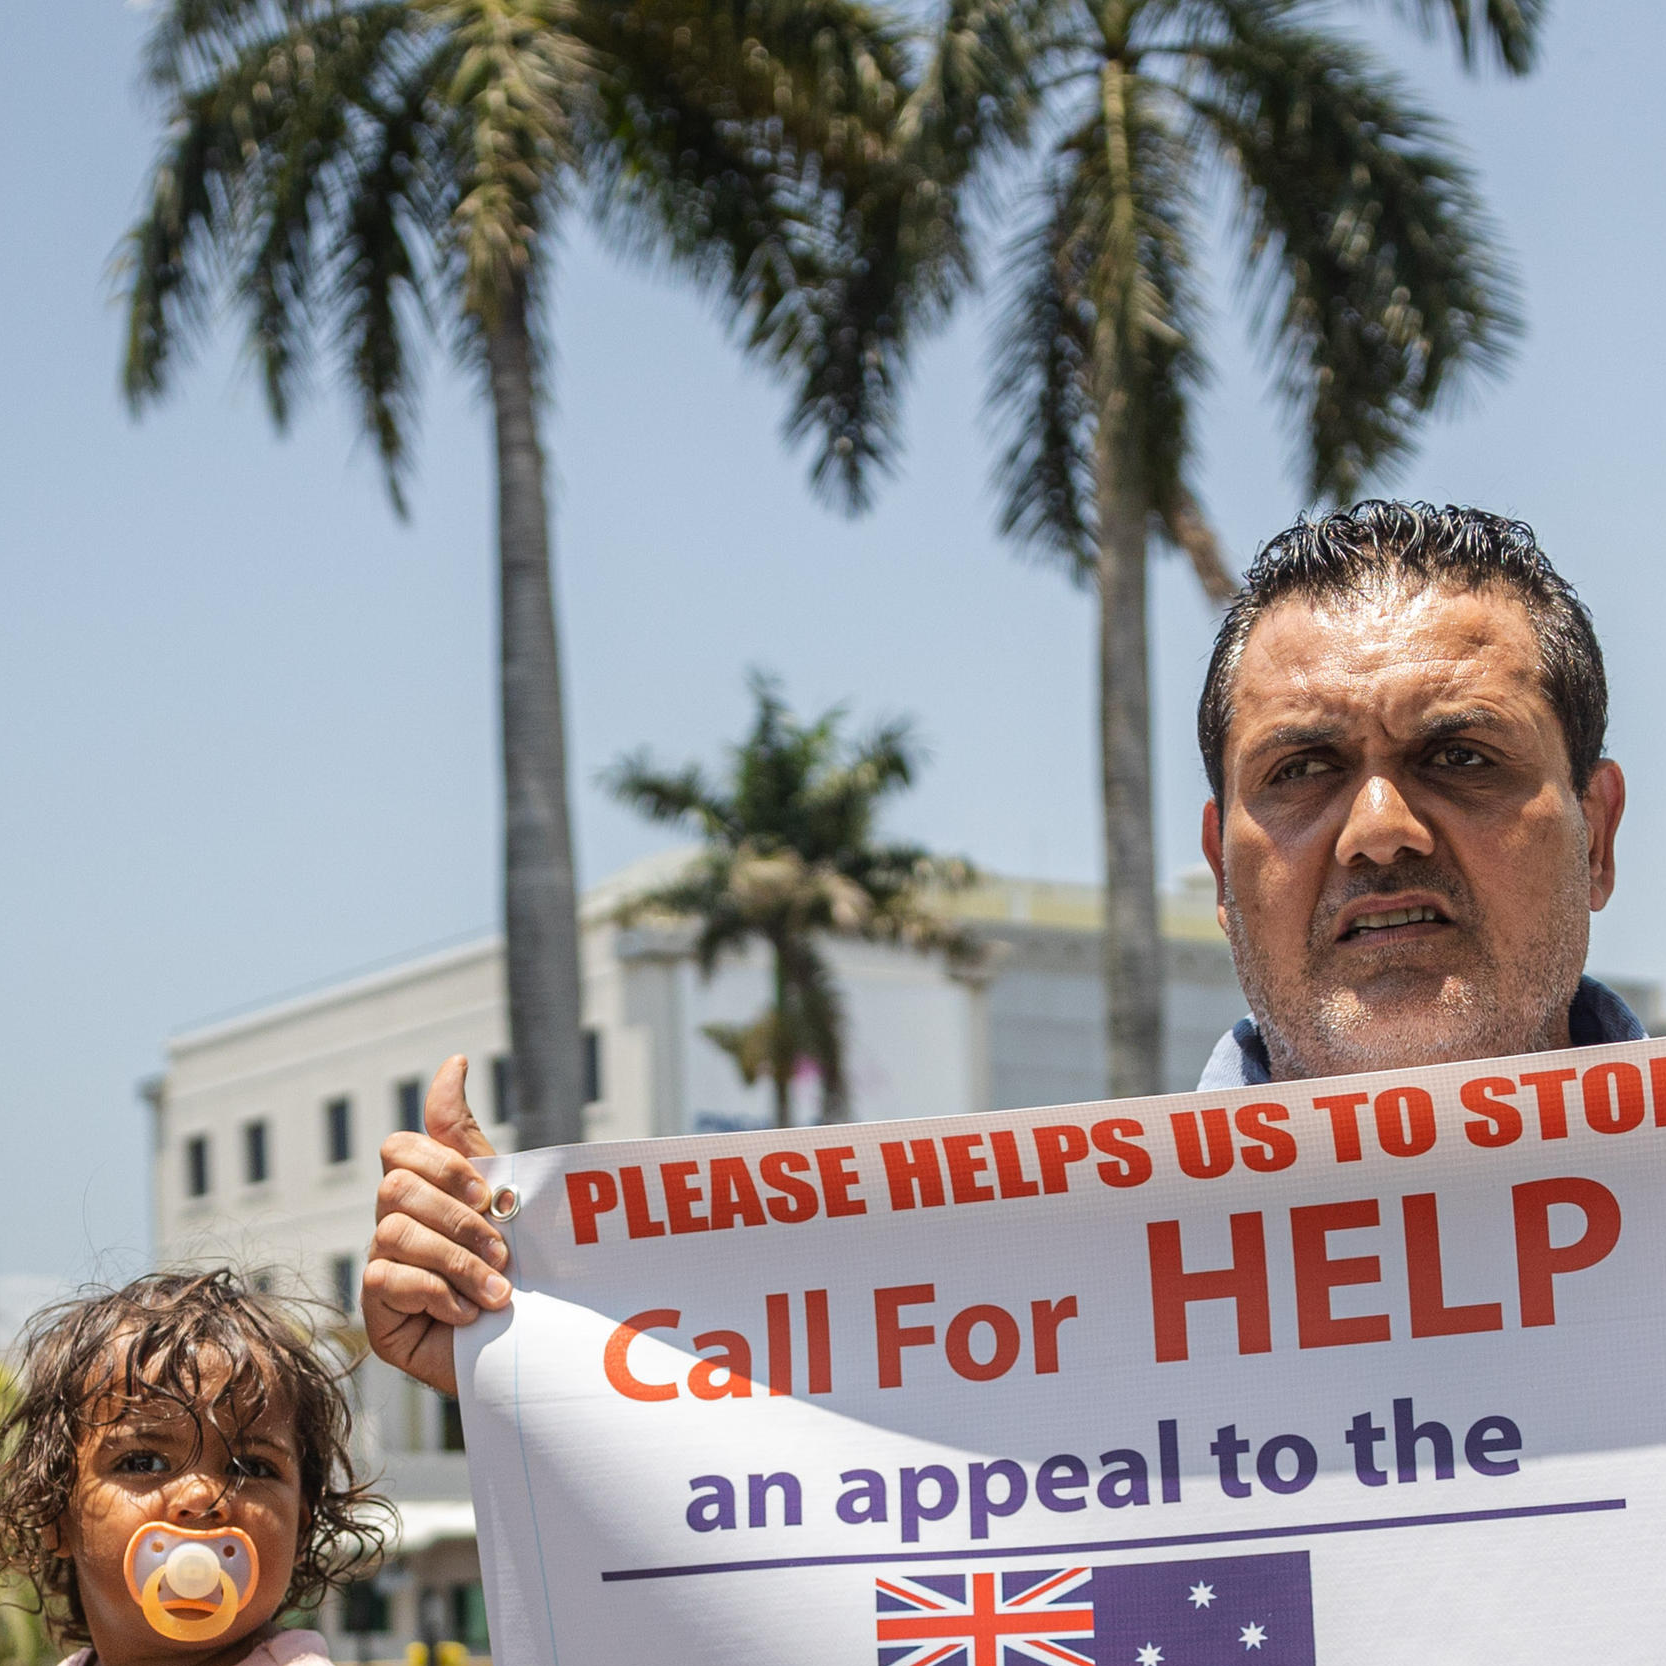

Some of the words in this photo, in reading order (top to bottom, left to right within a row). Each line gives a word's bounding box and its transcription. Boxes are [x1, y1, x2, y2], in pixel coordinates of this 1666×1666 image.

[565, 1145, 867, 1245] PLEASE
[878, 1117, 1153, 1211] HELPS
[1168, 1101, 1299, 1180] US
[1311, 1085, 1453, 1164] TO
[603, 1289, 832, 1403] Call
[874, 1284, 1078, 1389] For
[1146, 1177, 1621, 1363] HELP
[685, 1471, 803, 1533] an
[835, 1418, 1182, 1544] appeal
[1209, 1423, 1318, 1499] to
[1344, 1397, 1523, 1488] the
